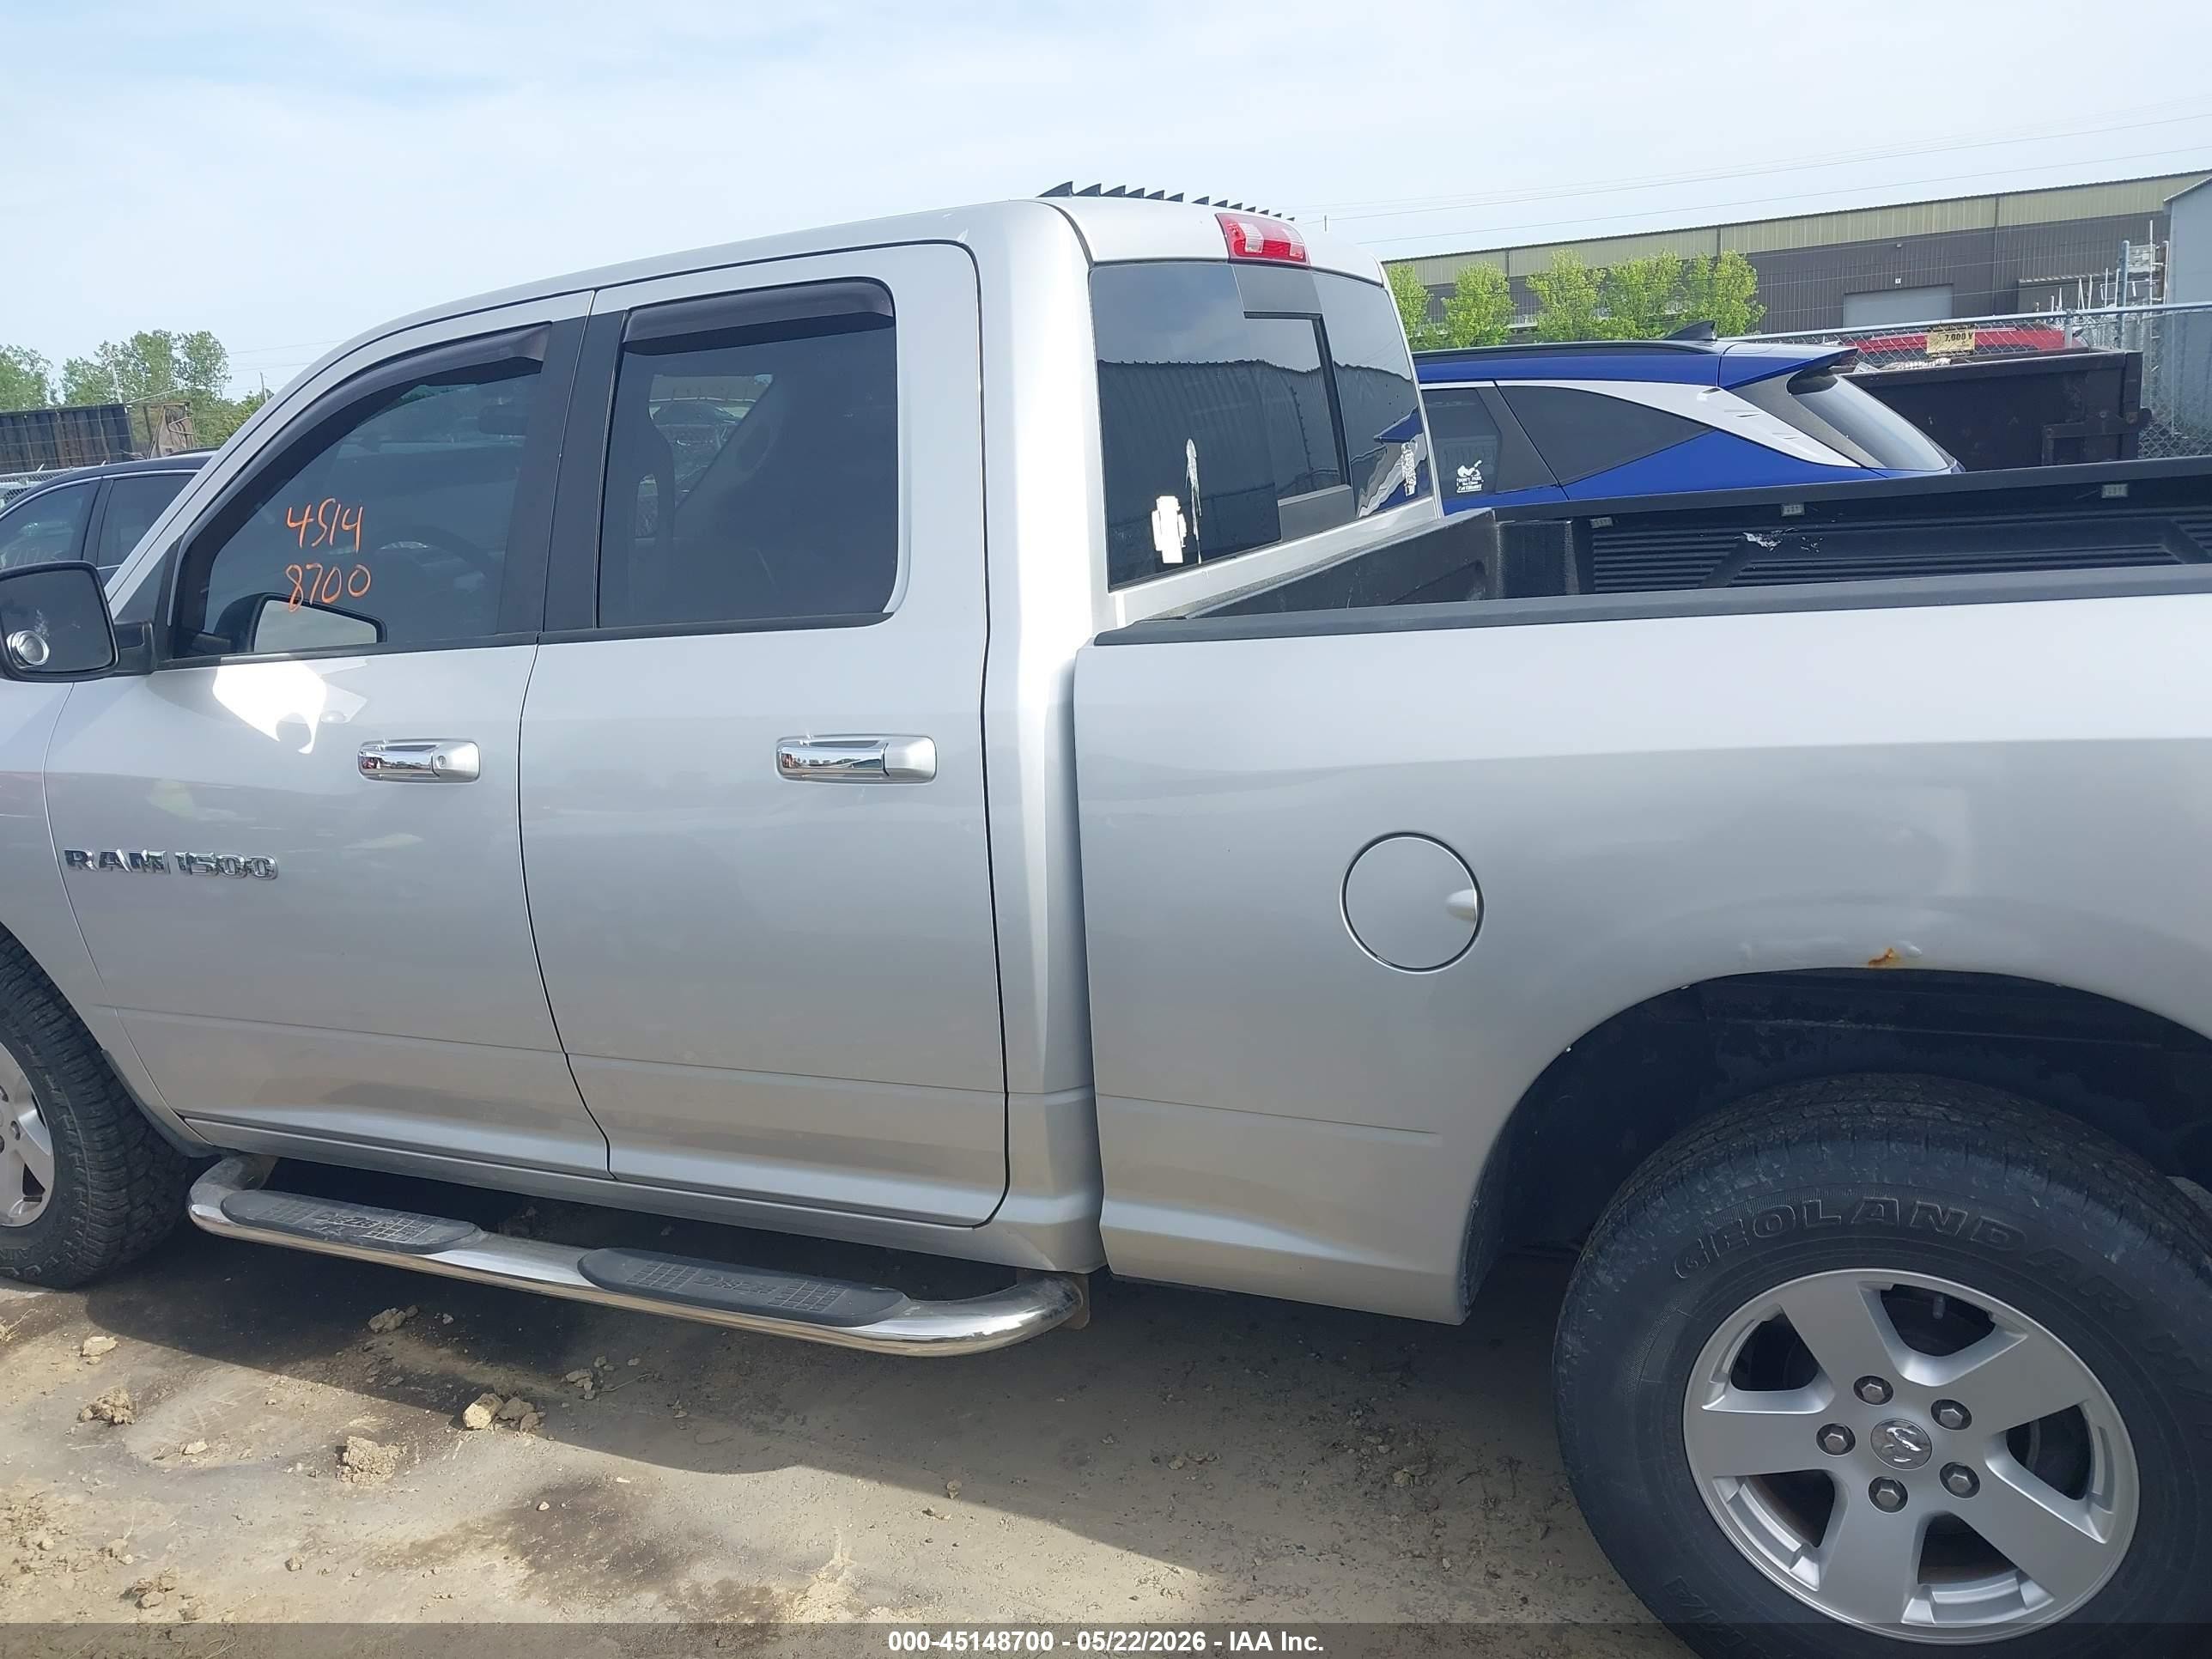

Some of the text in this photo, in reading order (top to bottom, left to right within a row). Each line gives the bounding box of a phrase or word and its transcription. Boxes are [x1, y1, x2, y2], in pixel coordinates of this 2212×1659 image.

[287, 498, 364, 554] 4514
[286, 563, 371, 612] 8700
[63, 848, 278, 880] RAM 1500
